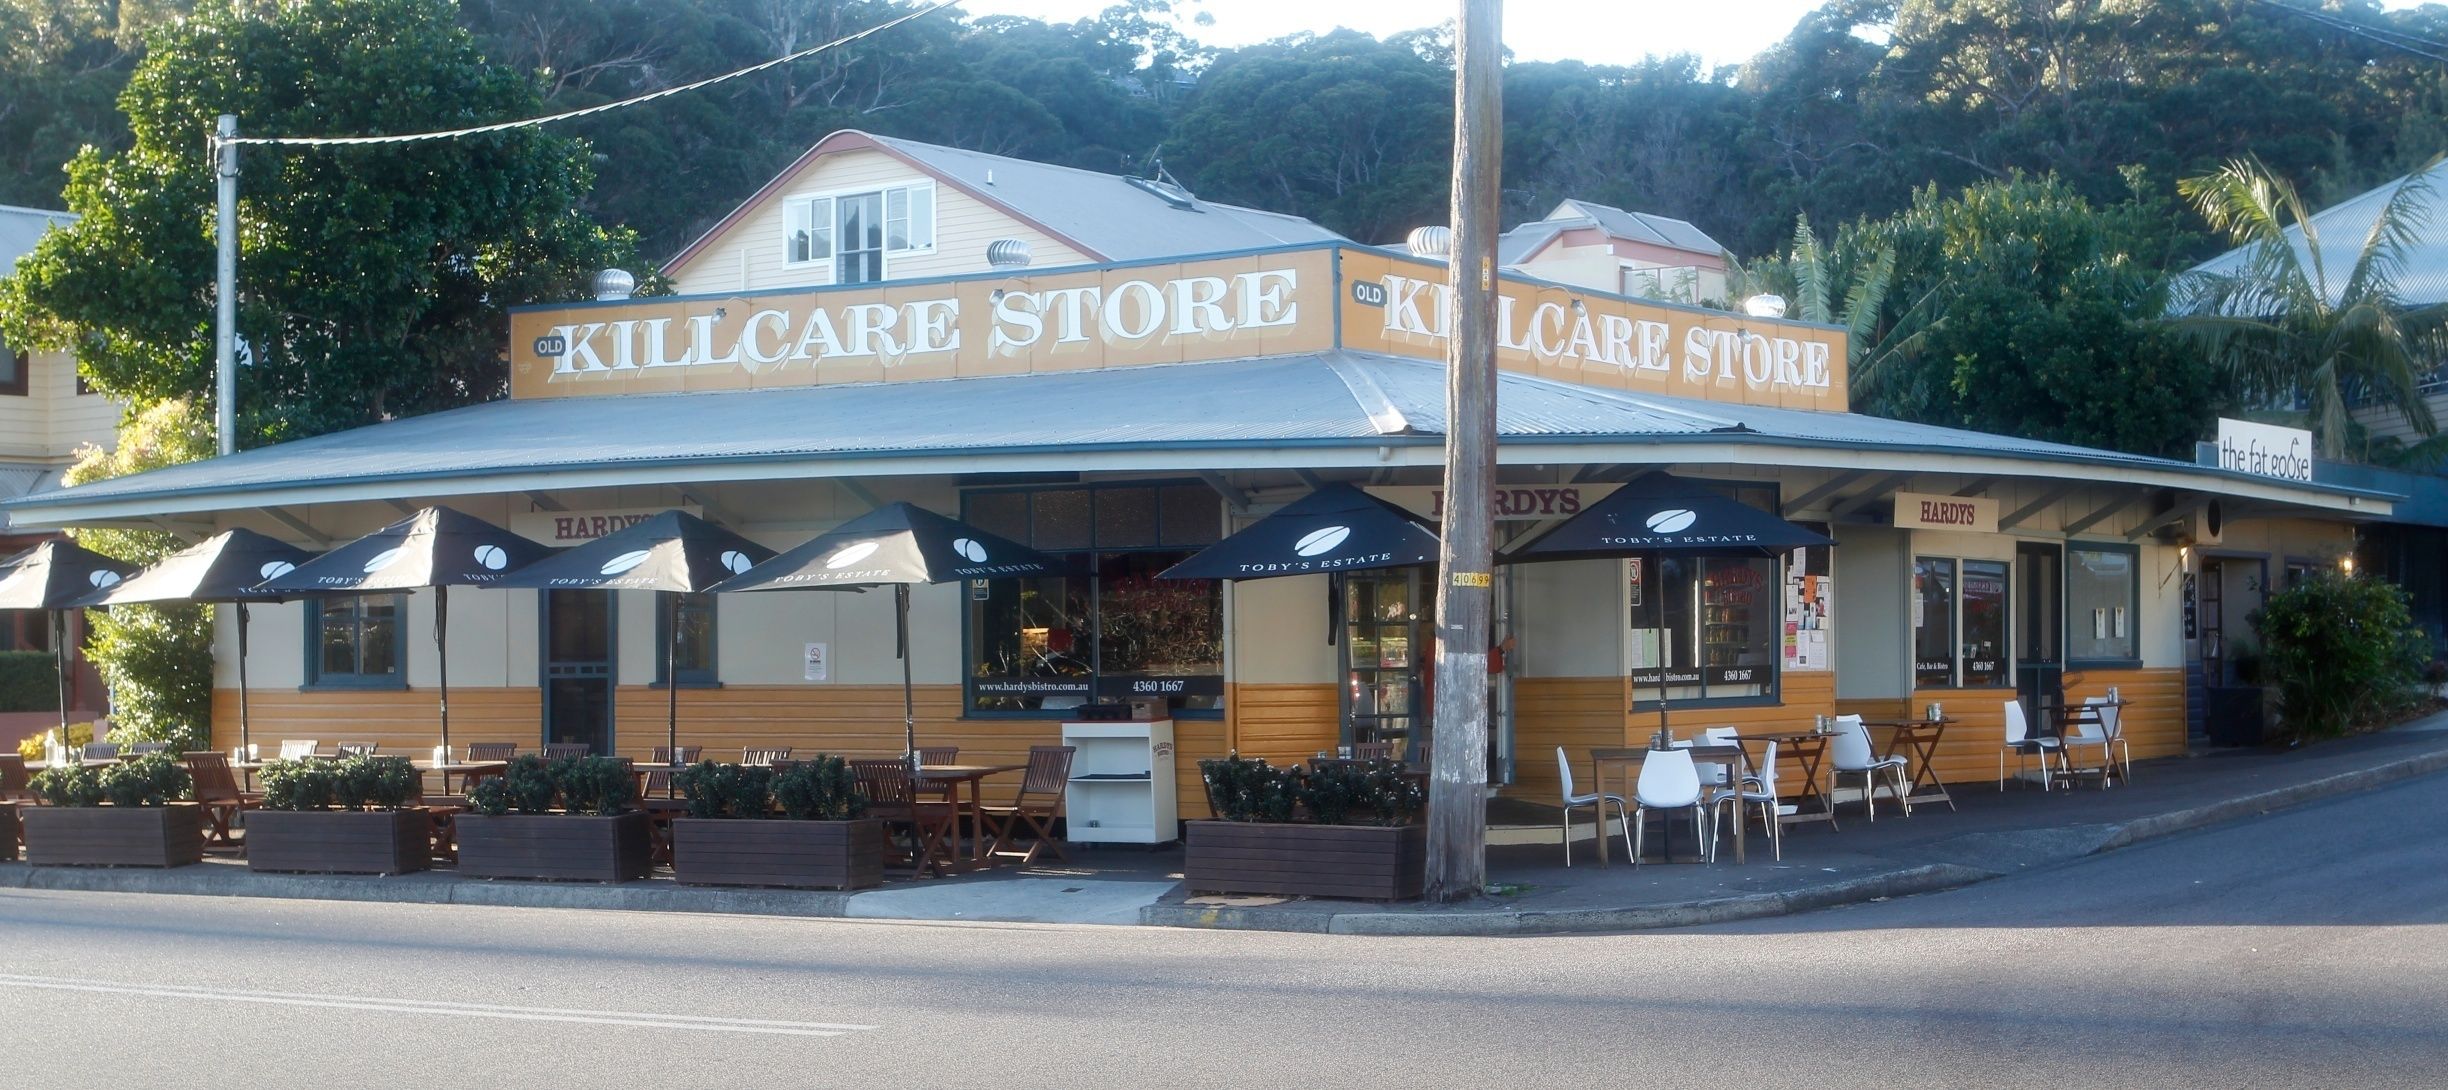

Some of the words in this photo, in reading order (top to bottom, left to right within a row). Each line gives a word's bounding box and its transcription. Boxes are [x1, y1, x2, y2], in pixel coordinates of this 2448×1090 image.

[538, 340, 562, 353] OLD
[553, 298, 961, 374] KILLCARE
[994, 268, 1297, 347] STORE
[1356, 284, 1382, 303] OLD
[1383, 274, 1670, 371] KILCARE
[1686, 326, 1830, 388] STORE
[2222, 436, 2246, 472] the
[2249, 438, 2268, 475] fat
[2271, 437, 2309, 480] goose
[1431, 488, 1581, 516] RDYS
[1920, 500, 1975, 525] HARDYS
[555, 514, 654, 539] HARDY
[1601, 536, 1673, 544] TOBY'S
[1683, 534, 1757, 543] ESTATE
[1239, 561, 1310, 572] TOBY'S
[1320, 552, 1391, 568] ESTATE
[1453, 574, 1489, 585] 40699
[1633, 672, 1700, 683] www.hardbistro.com.au
[1723, 670, 1738, 681] 4360
[1739, 669, 1752, 680] 1667
[979, 681, 1089, 694] www.hardysbistro.com.au
[1132, 680, 1158, 692] 4360
[1160, 680, 1184, 692] 1667
